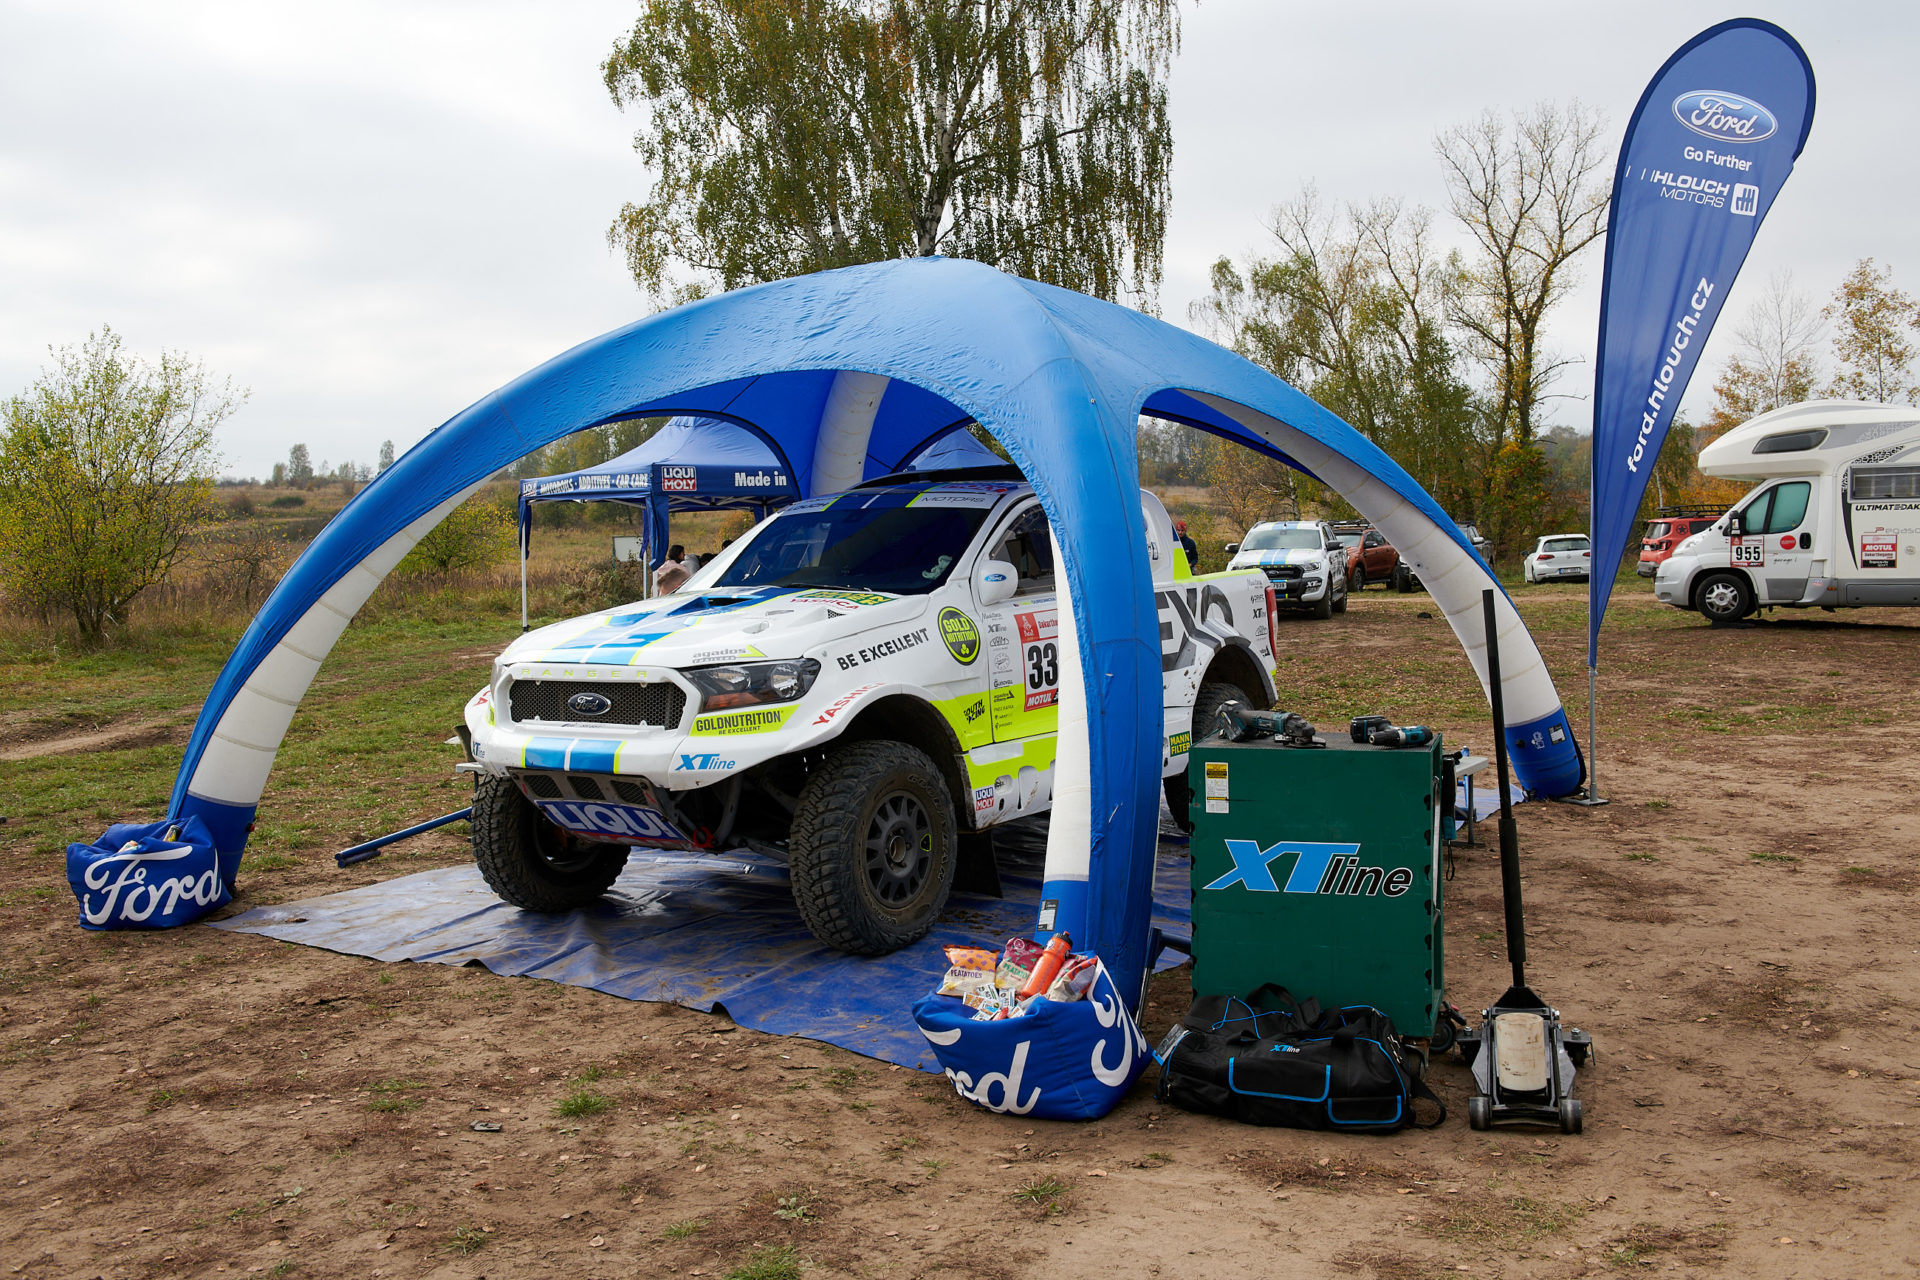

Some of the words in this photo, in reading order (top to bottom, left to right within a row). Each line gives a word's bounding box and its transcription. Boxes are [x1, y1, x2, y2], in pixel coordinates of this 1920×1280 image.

[1690, 97, 1758, 137] Ford
[1683, 146, 1703, 162] Go
[1705, 150, 1752, 171] Further
[1653, 170, 1730, 196] HLOUCH
[1660, 186, 1725, 208] MOTORS
[1627, 277, 1715, 473] ford.hlouch.cz
[663, 467, 695, 479] LIQUI
[734, 471, 771, 487] Made
[774, 470, 787, 486] in
[615, 474, 630, 489] CAR
[663, 479, 695, 490] MOLY
[1735, 546, 1761, 561] 955
[943, 617, 972, 632] GOLD
[946, 631, 976, 643] NUTRITION
[693, 648, 746, 658] agados
[837, 652, 859, 671] BE
[858, 628, 930, 663] EXCELLENT
[521, 668, 647, 679] RANGER
[575, 695, 599, 711] Ford
[1027, 693, 1052, 706] MOTUL
[696, 711, 781, 732] GOLDNUTRITION
[1170, 733, 1190, 745] MANN
[1171, 742, 1191, 754] FILTER
[675, 753, 735, 771] XTline
[976, 787, 993, 800] LIQUI
[976, 799, 994, 811] MOLY
[547, 802, 677, 839] LIQUI
[1203, 839, 1413, 897] XTline
[84, 845, 222, 926] Ford
[1269, 1044, 1301, 1054] XTline
